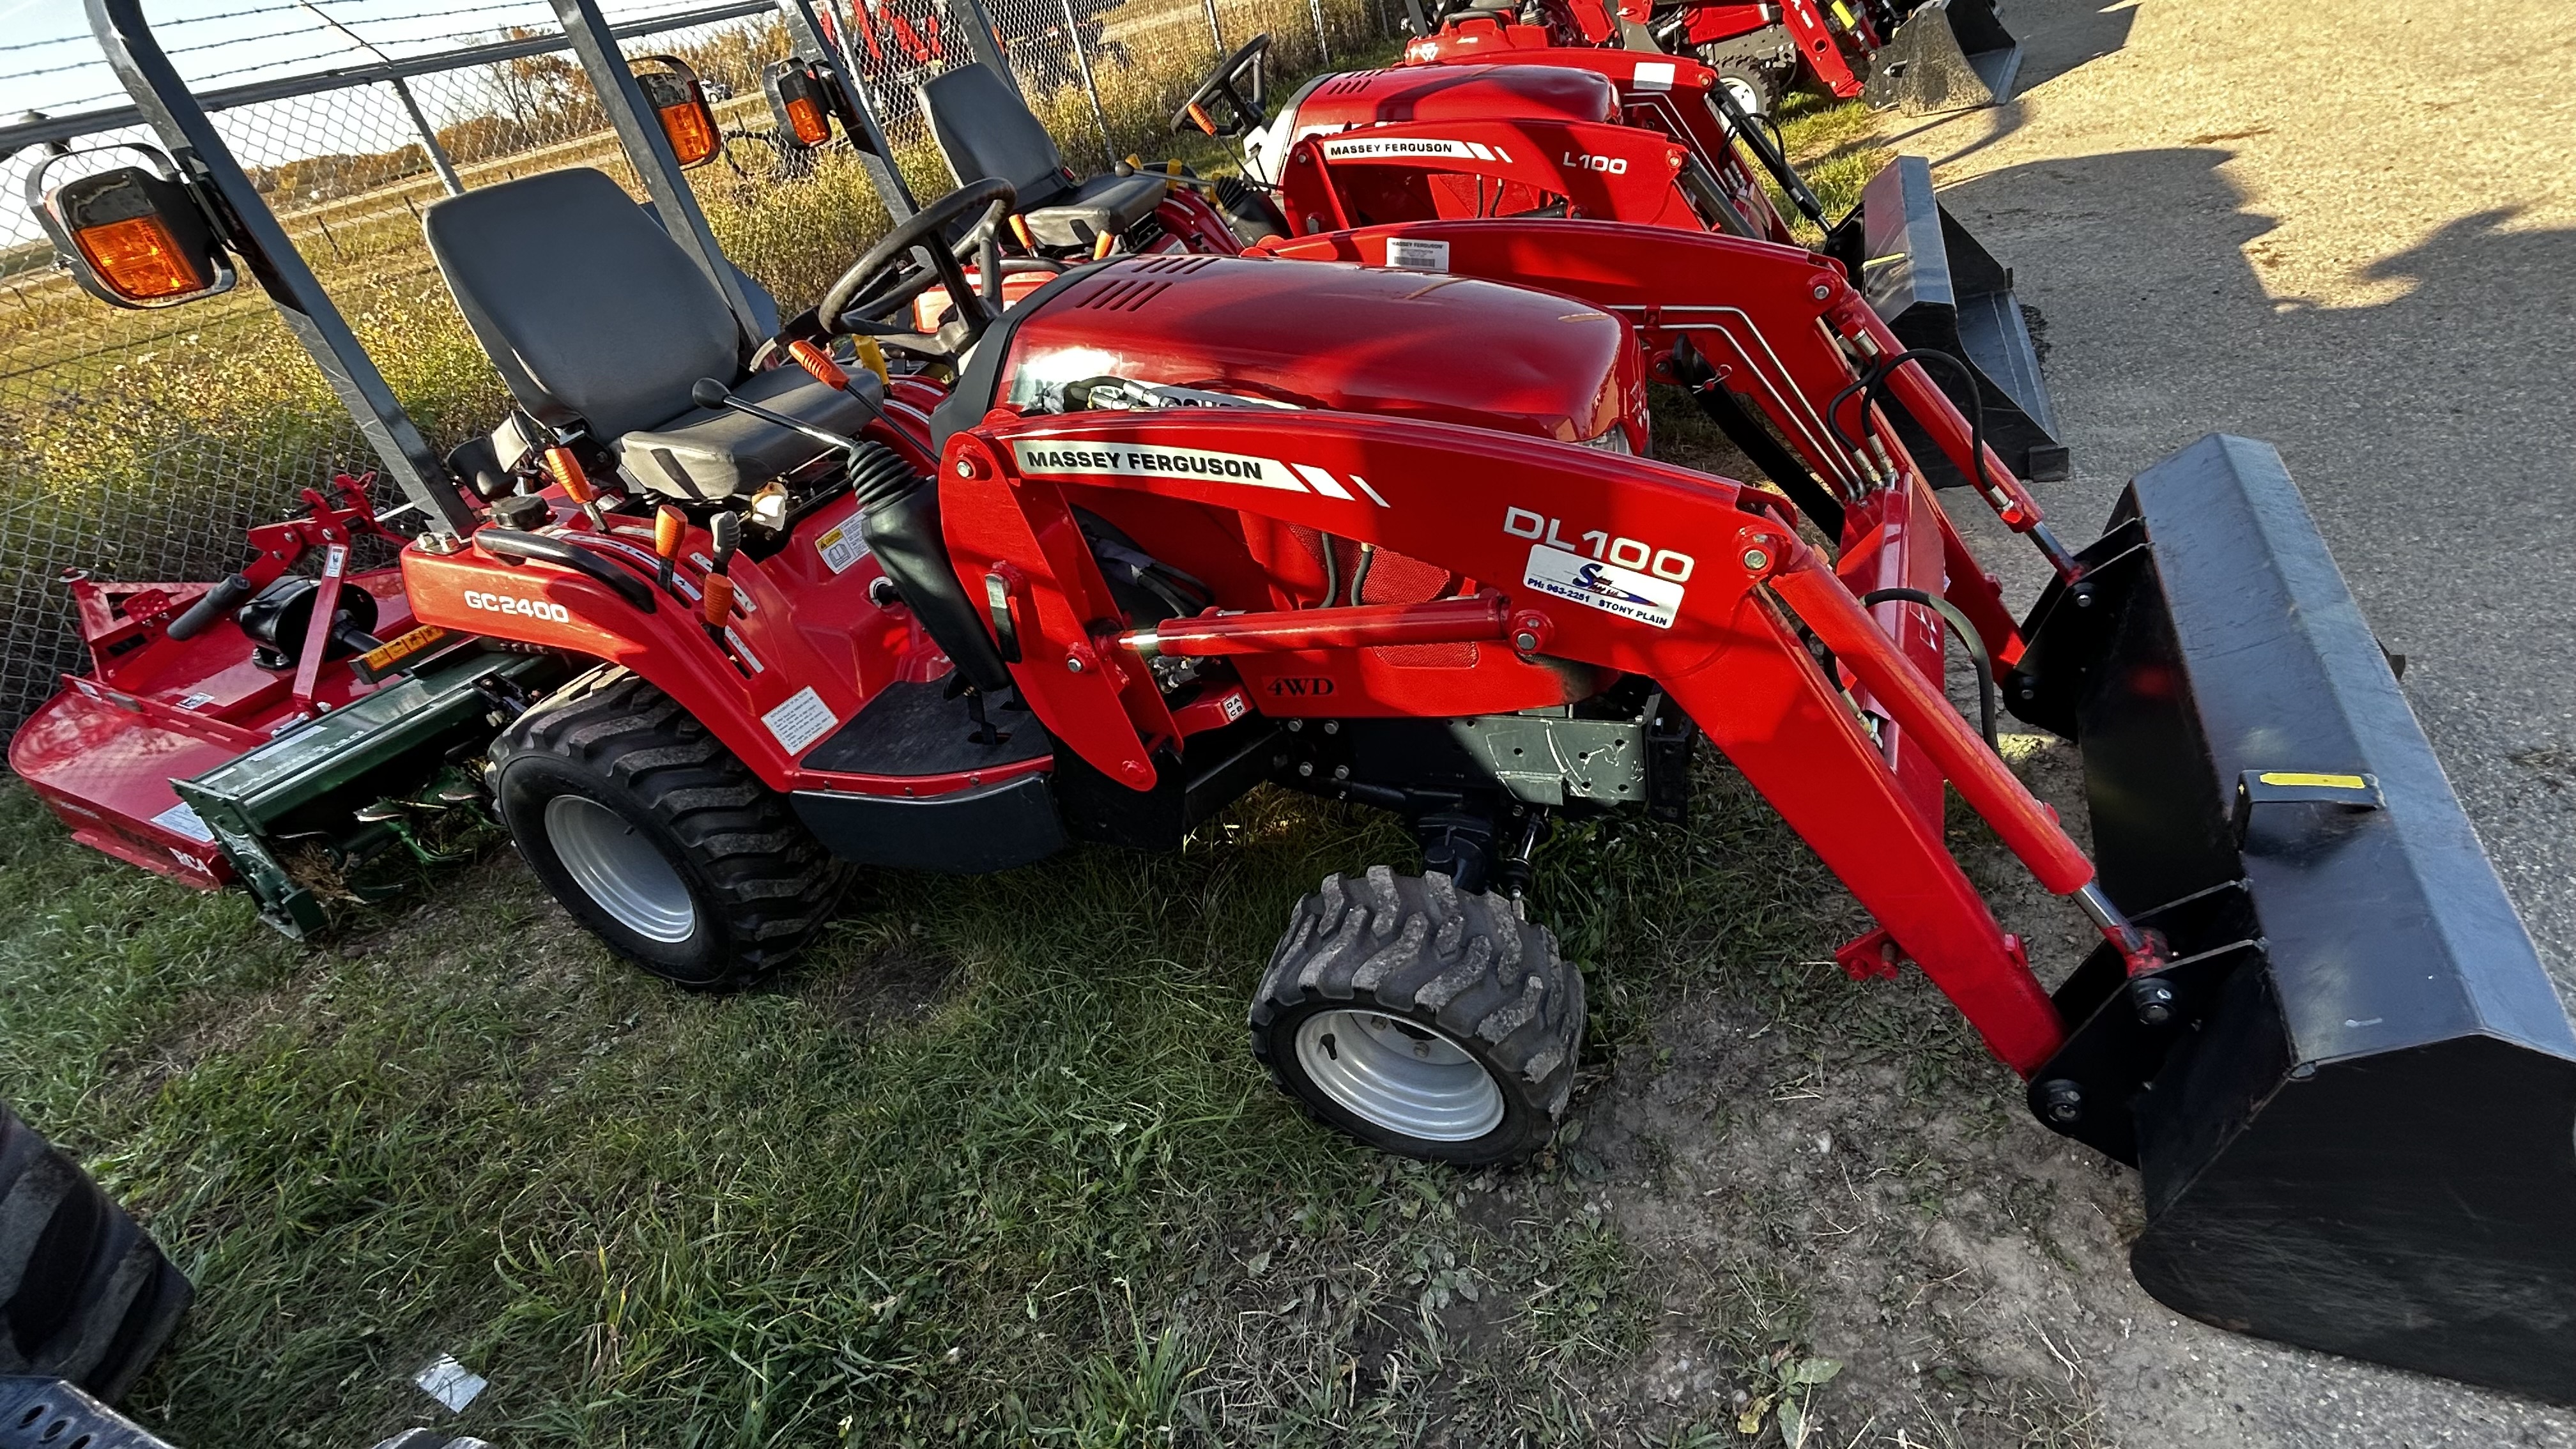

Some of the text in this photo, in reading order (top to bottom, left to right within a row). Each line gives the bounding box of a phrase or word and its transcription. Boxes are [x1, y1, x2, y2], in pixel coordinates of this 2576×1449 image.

[1330, 143, 1452, 156] MASSEY FERGUSON
[1563, 151, 1628, 174] L100
[1027, 451, 1262, 480] MASSEY FERGUSON
[1503, 506, 1695, 583] DL100
[464, 590, 569, 624] GC2400
[1527, 577, 1545, 590] PH:
[1546, 583, 1590, 602] 963-2251
[1598, 599, 1634, 615] STONY
[1636, 610, 1668, 626] PLAIN
[1267, 677, 1335, 696] 4WD
